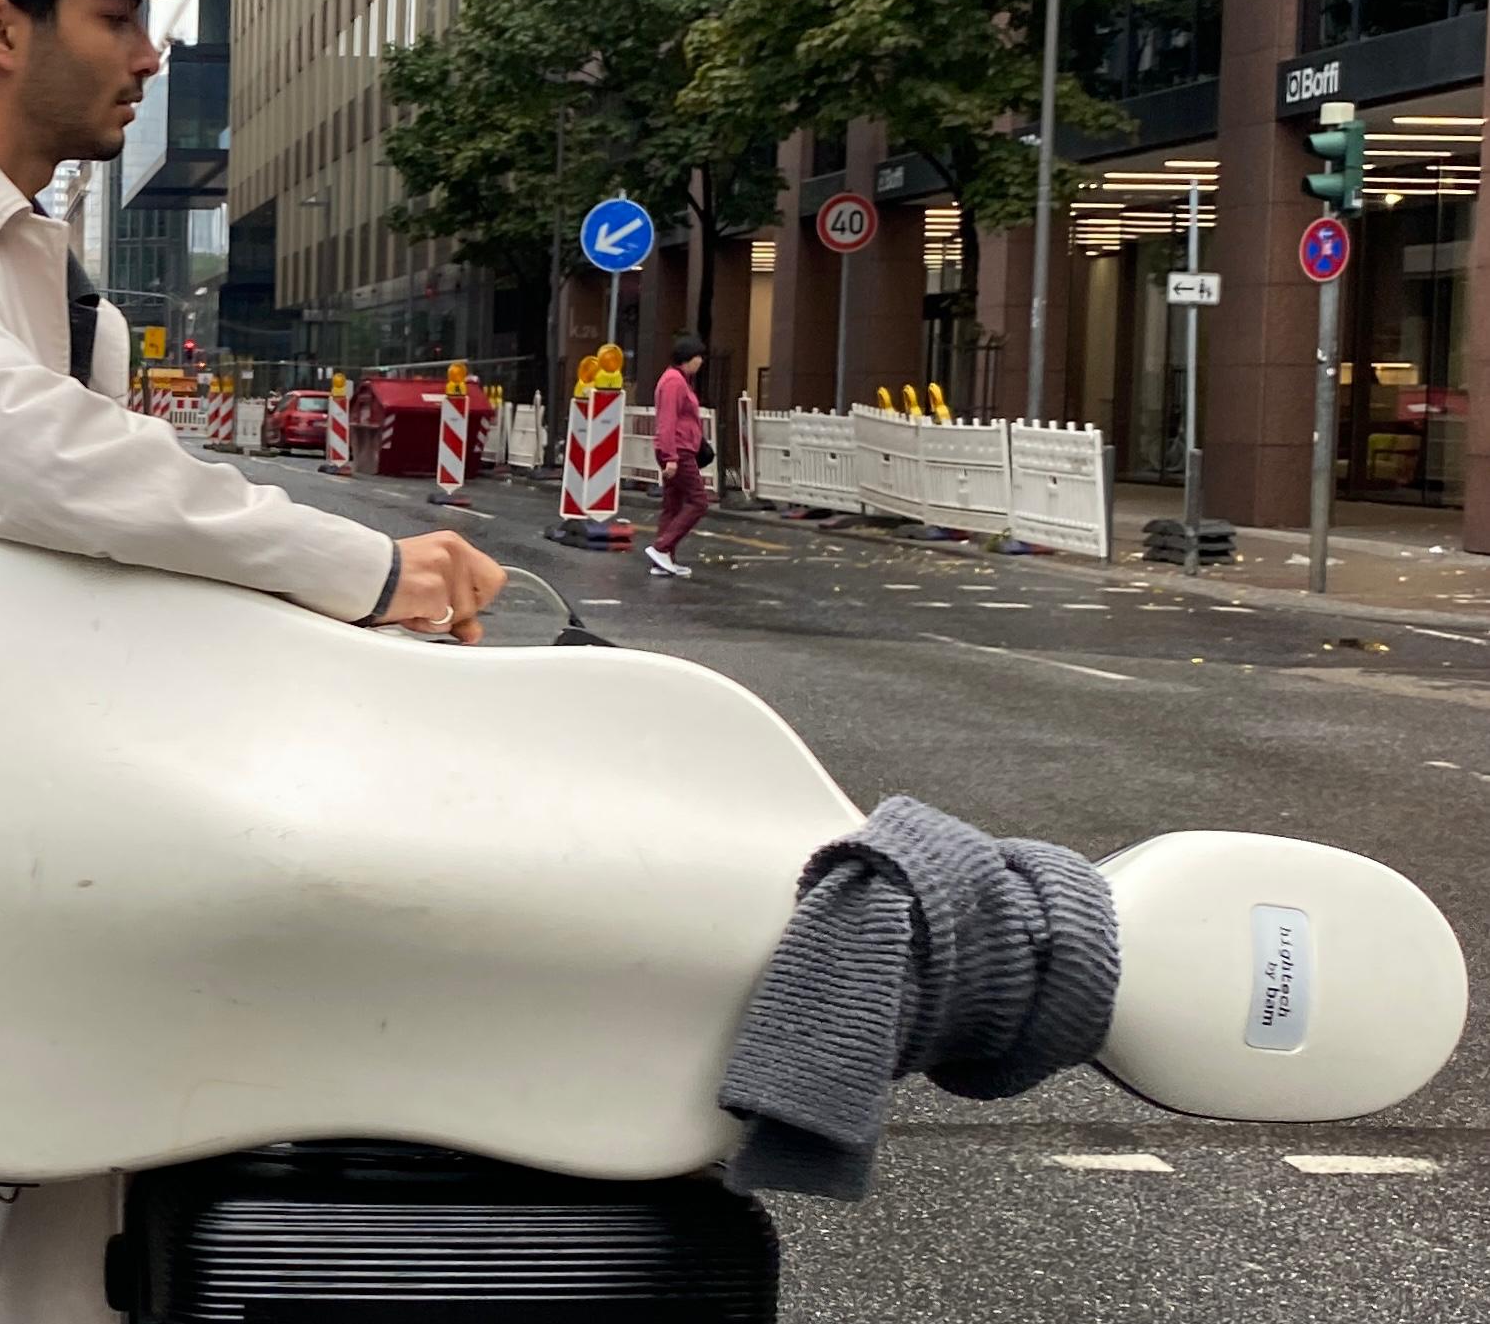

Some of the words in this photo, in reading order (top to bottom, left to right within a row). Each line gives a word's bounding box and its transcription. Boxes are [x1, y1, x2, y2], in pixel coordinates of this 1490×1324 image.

[1300, 61, 1340, 100] Boffi
[830, 210, 864, 235] 40
[1265, 961, 1278, 980] by
[1279, 925, 1294, 1018] hightech
[1262, 986, 1280, 1027] bam
